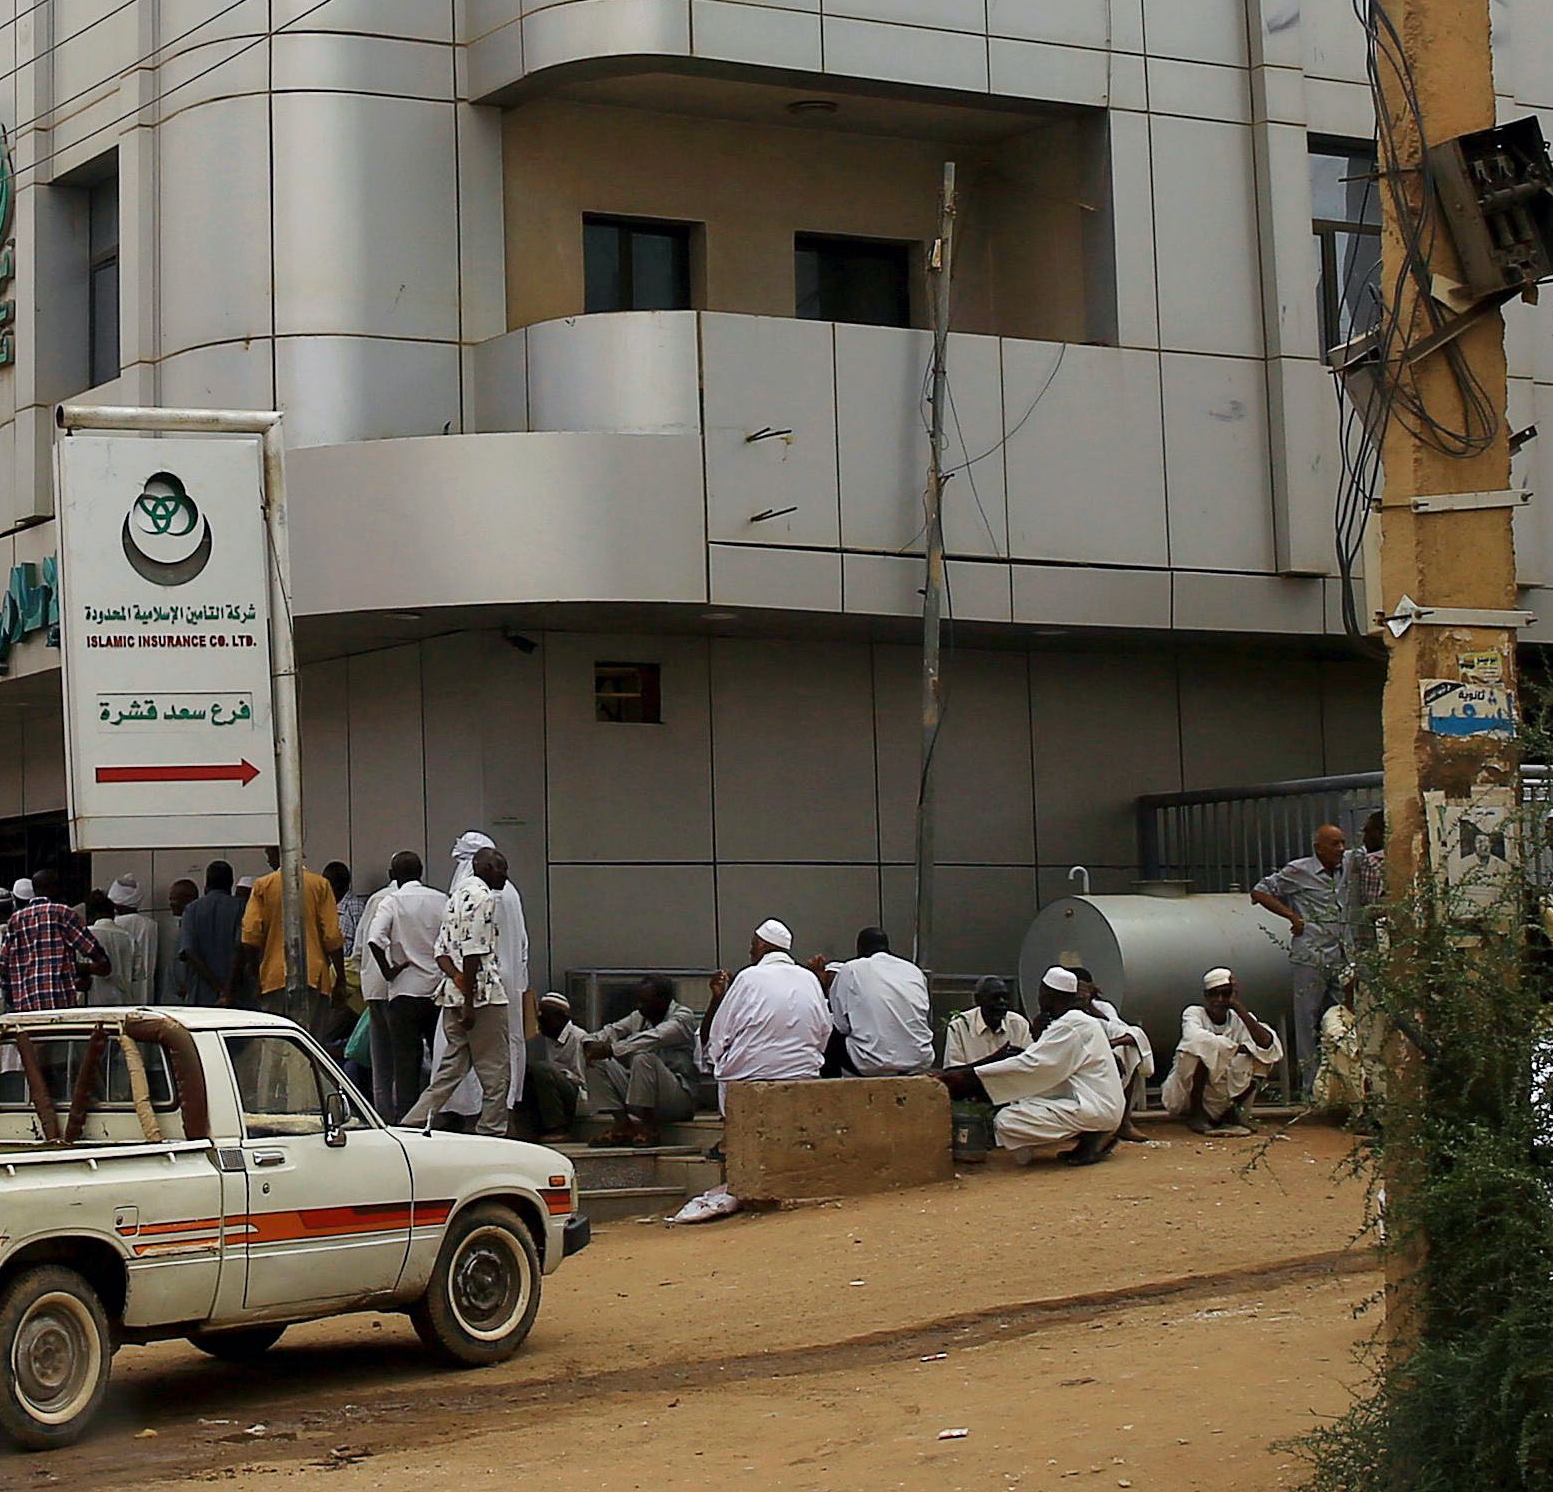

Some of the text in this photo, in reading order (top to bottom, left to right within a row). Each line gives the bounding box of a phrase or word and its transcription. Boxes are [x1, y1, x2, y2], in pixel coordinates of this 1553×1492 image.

[85, 605, 132, 624] المحدودة
[134, 604, 183, 625] الإسلامية
[227, 604, 256, 623] شركة
[87, 635, 257, 648] ISLAMIC INSURANCE CO. LTD.
[1458, 689, 1486, 702] ثانوية
[99, 699, 251, 726] فرع سعد قشرة
